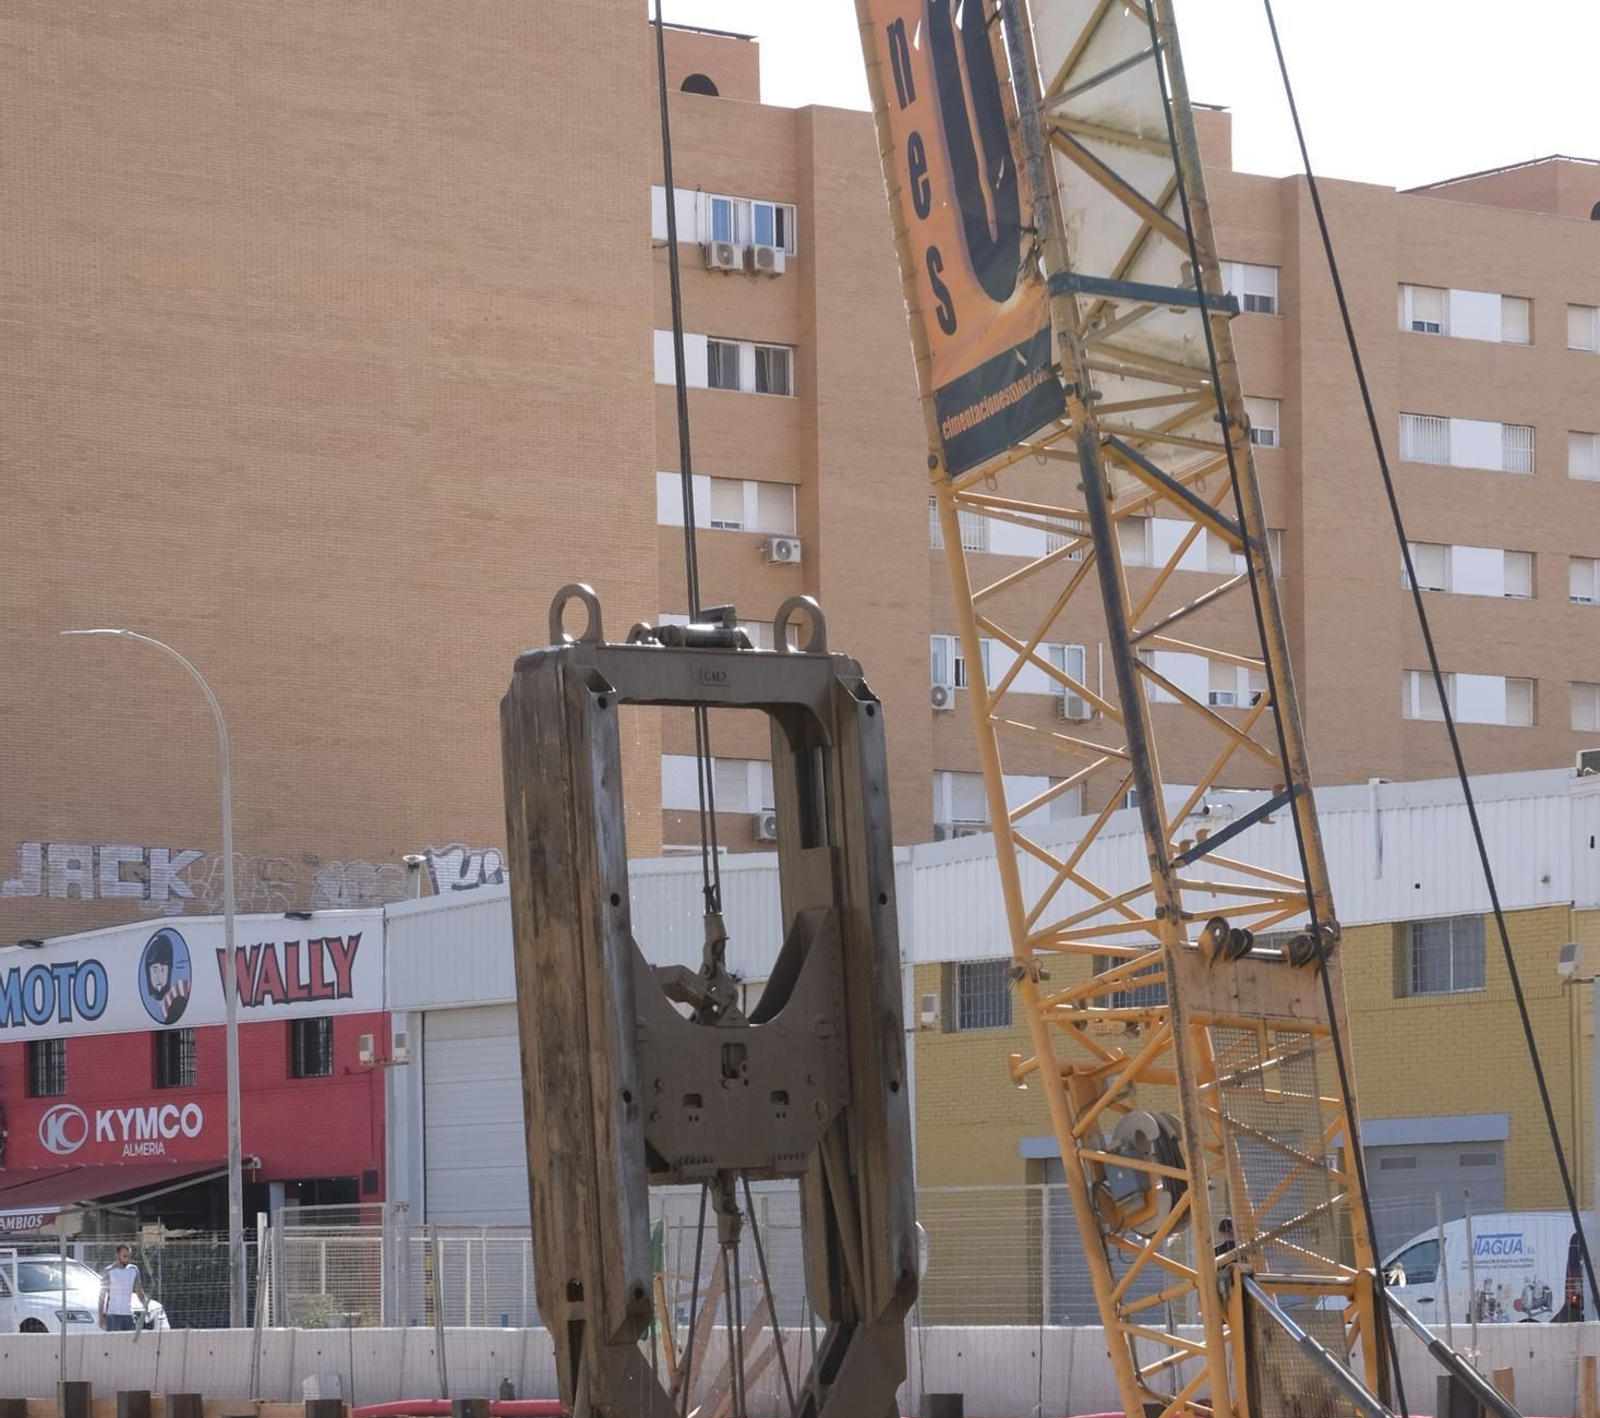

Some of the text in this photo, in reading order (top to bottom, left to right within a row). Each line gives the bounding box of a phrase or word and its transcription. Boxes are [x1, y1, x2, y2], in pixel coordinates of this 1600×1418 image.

[0, 841, 207, 900] JACK
[0, 932, 363, 1028] MOTO WALLY
[95, 1103, 204, 1143] KYMCO
[122, 1142, 166, 1157] ALMERIA
